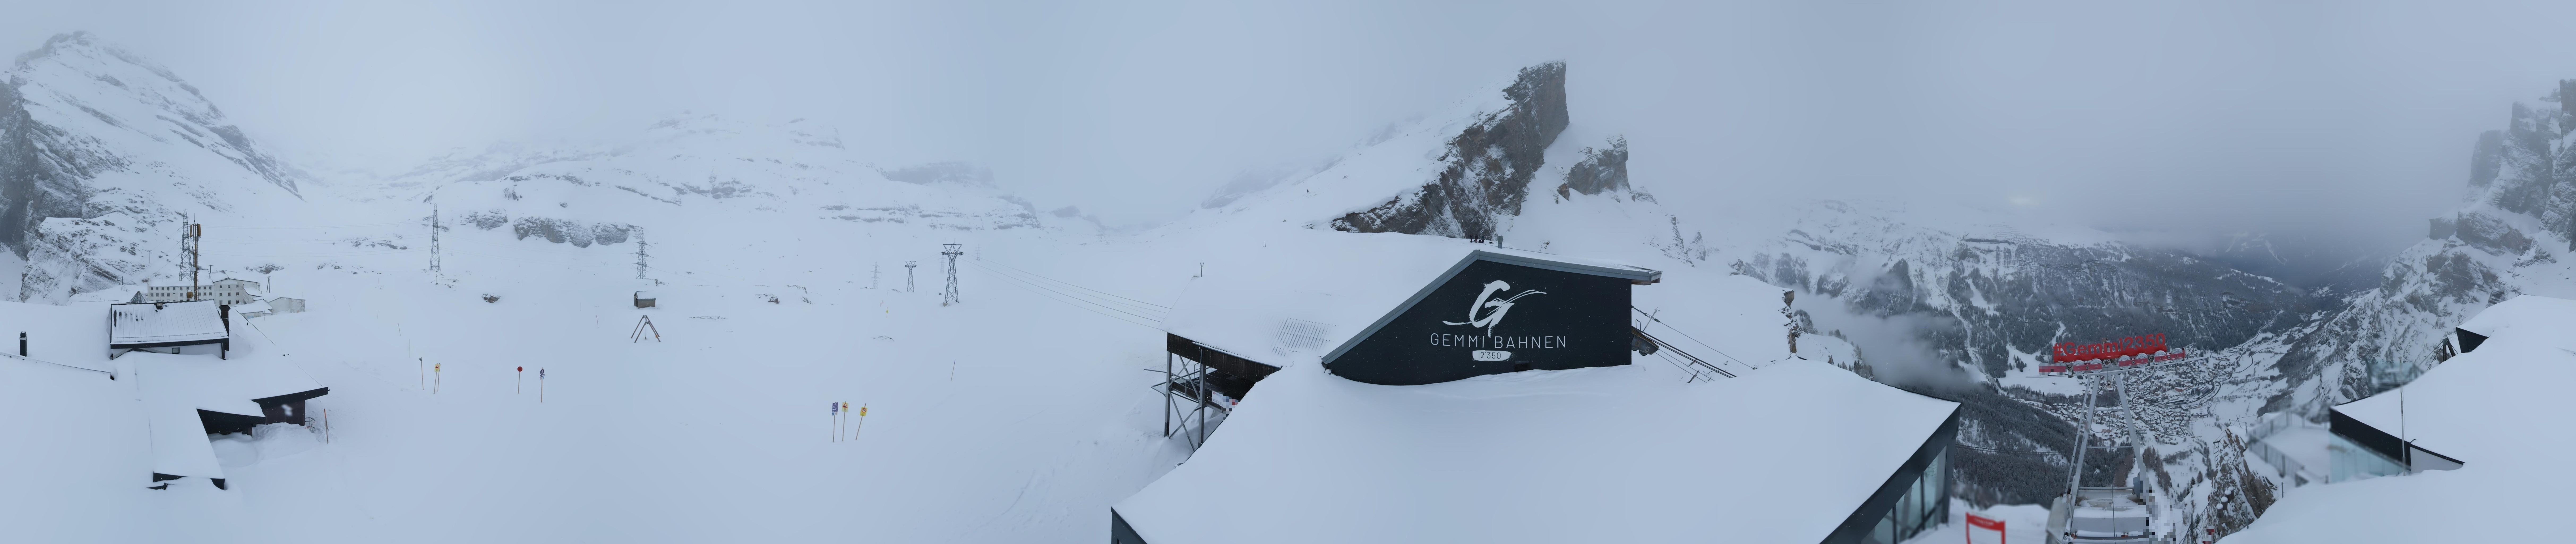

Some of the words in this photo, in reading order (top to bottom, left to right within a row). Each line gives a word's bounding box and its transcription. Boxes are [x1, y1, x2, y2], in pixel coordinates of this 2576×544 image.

[1431, 333, 1484, 348] GEMMI
[1495, 335, 1566, 349] BAHNEN
[2053, 333, 2166, 356] #Gemmi2350
[1480, 351, 1501, 359] 2'350
